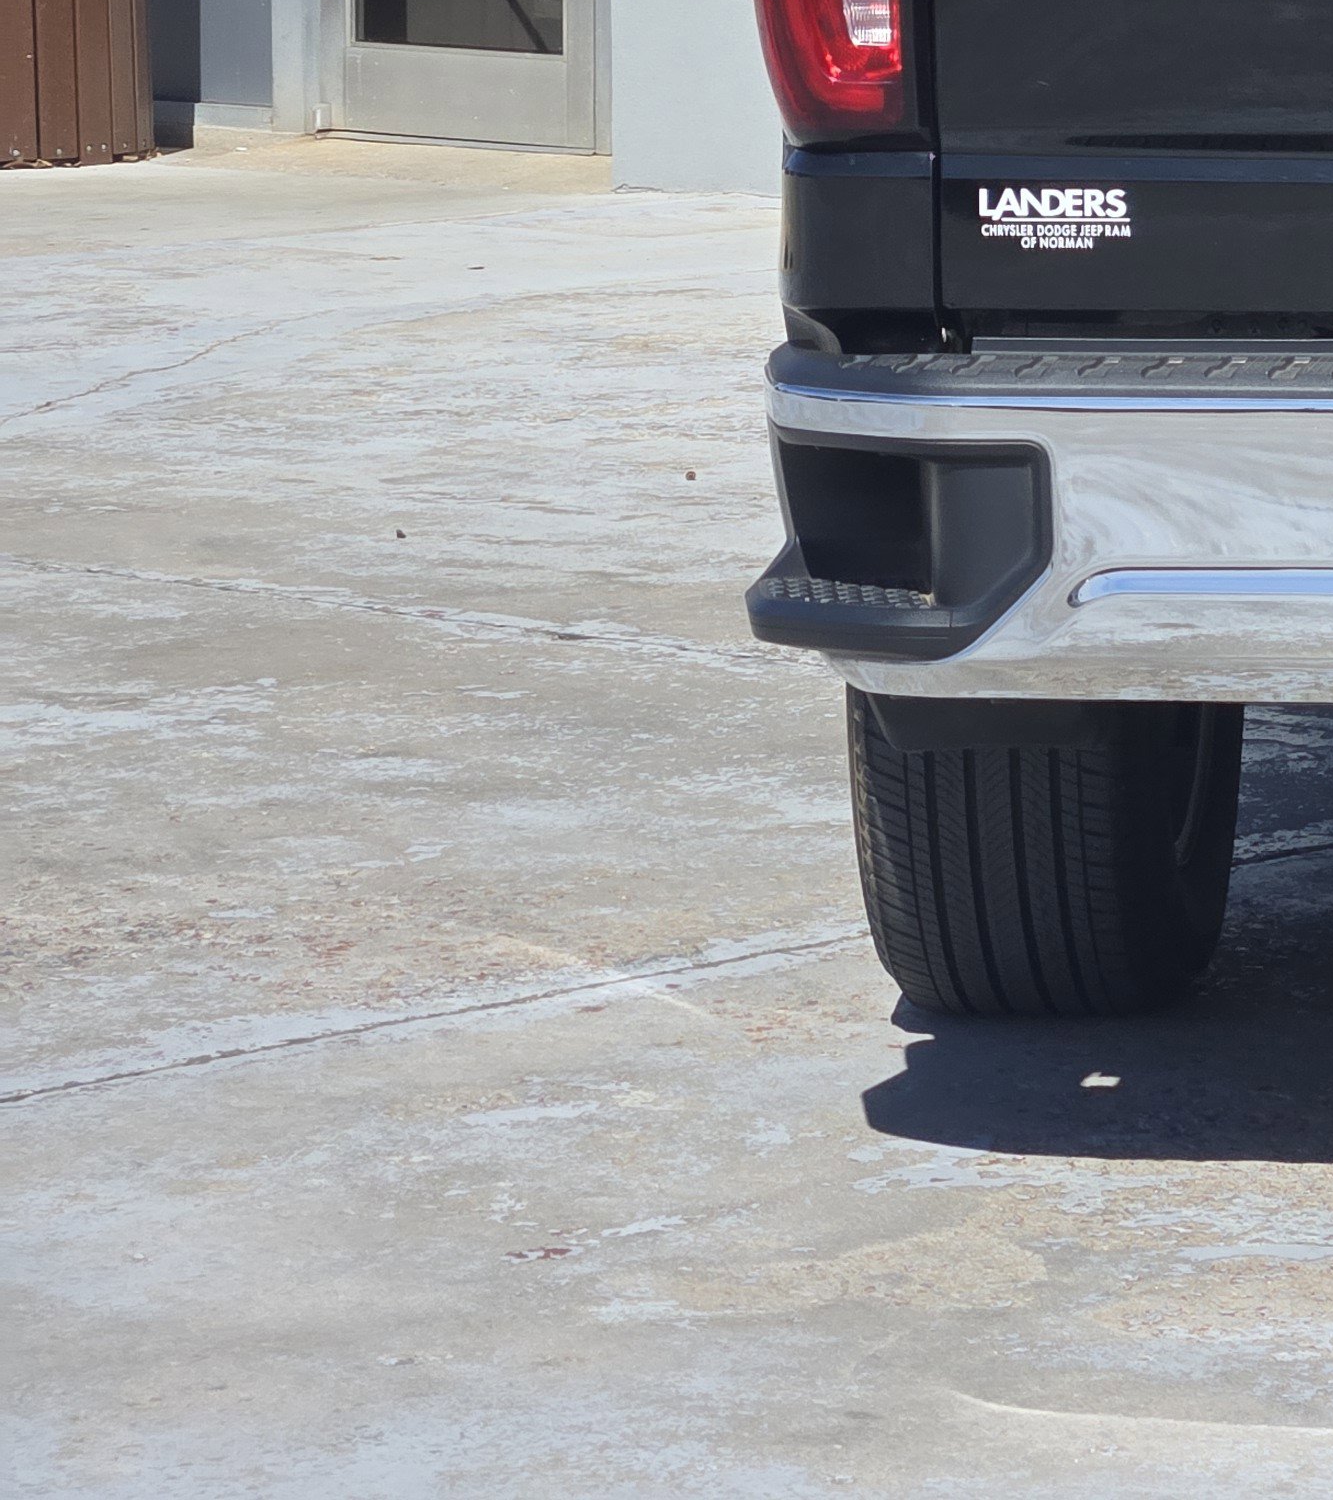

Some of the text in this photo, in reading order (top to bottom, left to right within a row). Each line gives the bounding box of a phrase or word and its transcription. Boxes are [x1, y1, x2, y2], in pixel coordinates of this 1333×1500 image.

[978, 188, 1128, 221] LANDERS
[981, 224, 1132, 238] CHRYSLER DODGE JEEP RAM
[1020, 237, 1094, 249] OF NORMAN
